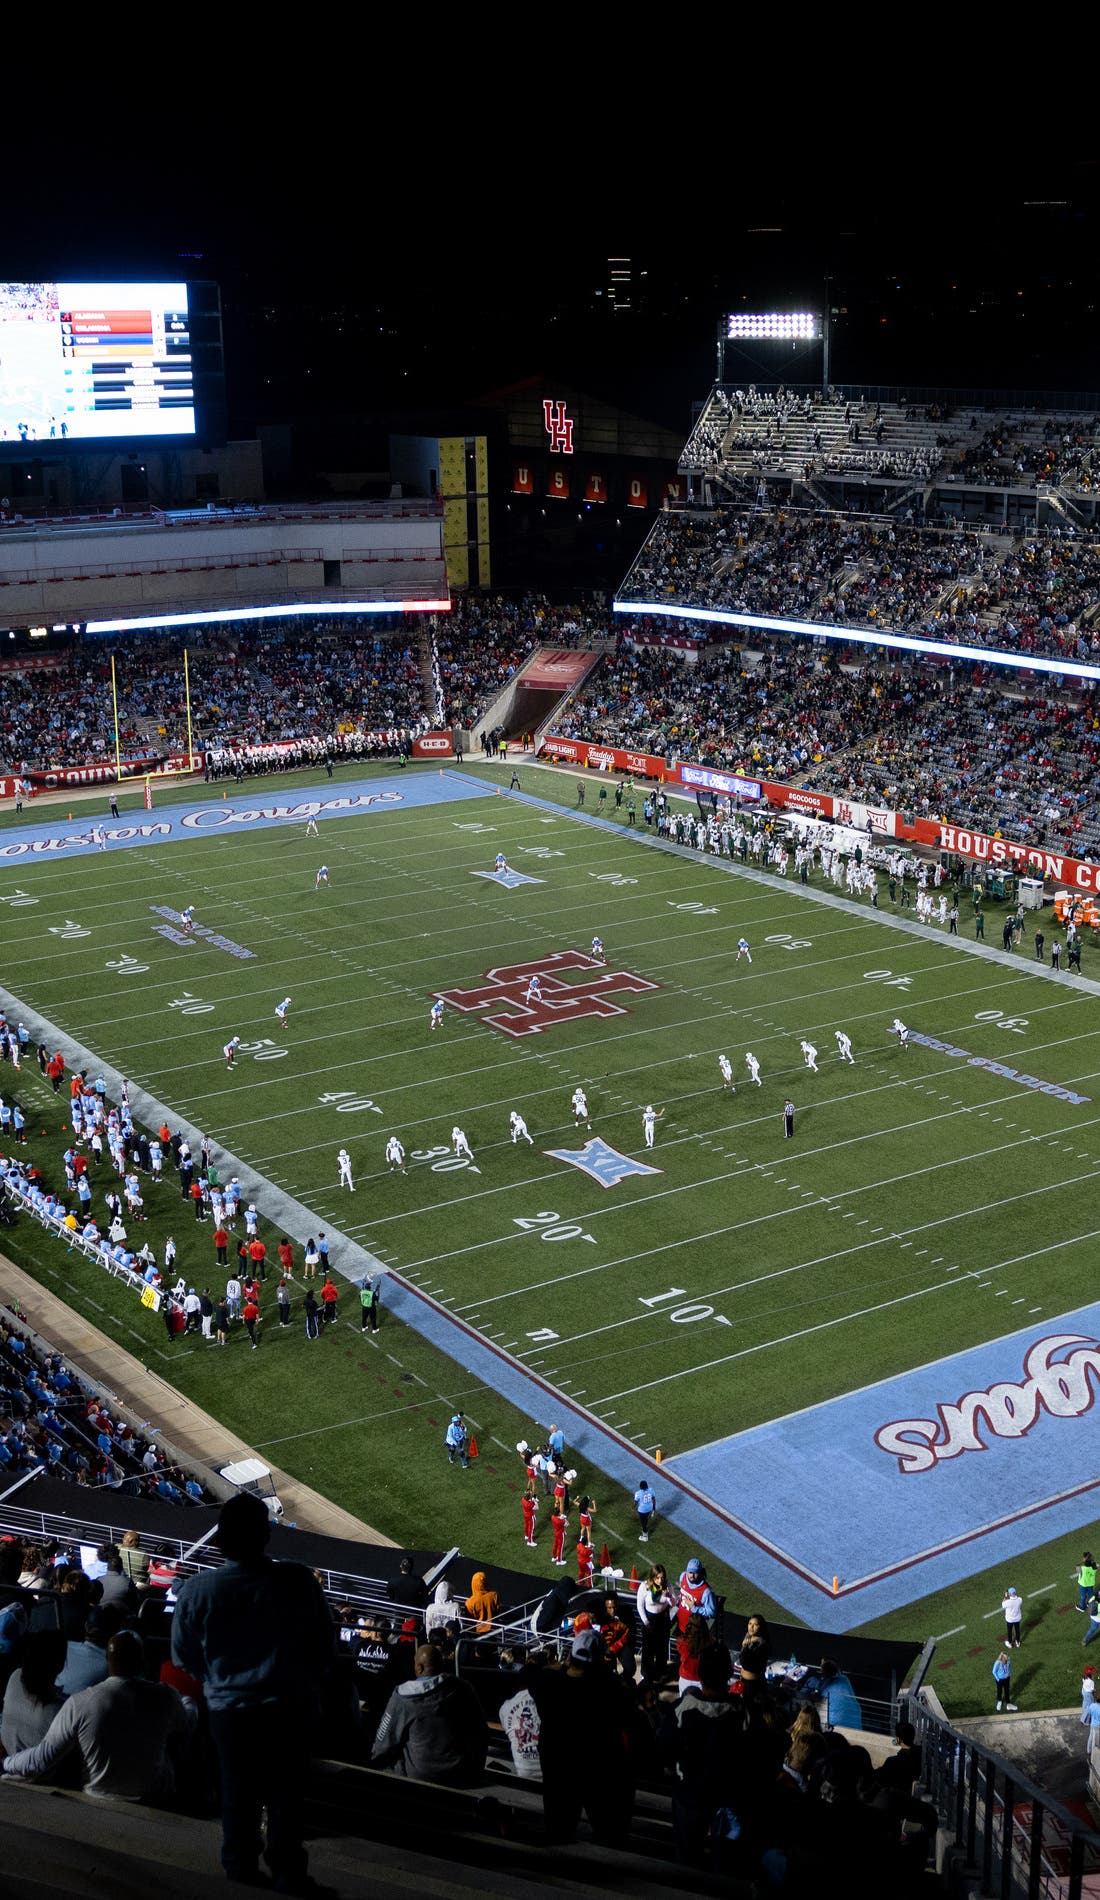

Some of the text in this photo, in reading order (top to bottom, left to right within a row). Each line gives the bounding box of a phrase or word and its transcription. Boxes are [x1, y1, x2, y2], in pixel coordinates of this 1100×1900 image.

[559, 745, 576, 756] LIGHT
[588, 747, 615, 762] Freddy's
[182, 792, 404, 828] Cougars
[939, 827, 1063, 879] HOUSTON
[676, 902, 721, 915] 40
[48, 924, 92, 939] 20
[764, 934, 813, 951] 50
[105, 957, 150, 975] 30
[863, 970, 914, 985] 40
[167, 998, 215, 1015] 40
[974, 1010, 1030, 1030] 30
[238, 1039, 289, 1060] 50
[966, 1057, 1092, 1105] STADIUM
[318, 1091, 373, 1112] 40
[410, 1146, 470, 1172] 30
[512, 1211, 582, 1241] 20
[638, 1287, 714, 1323] 10
